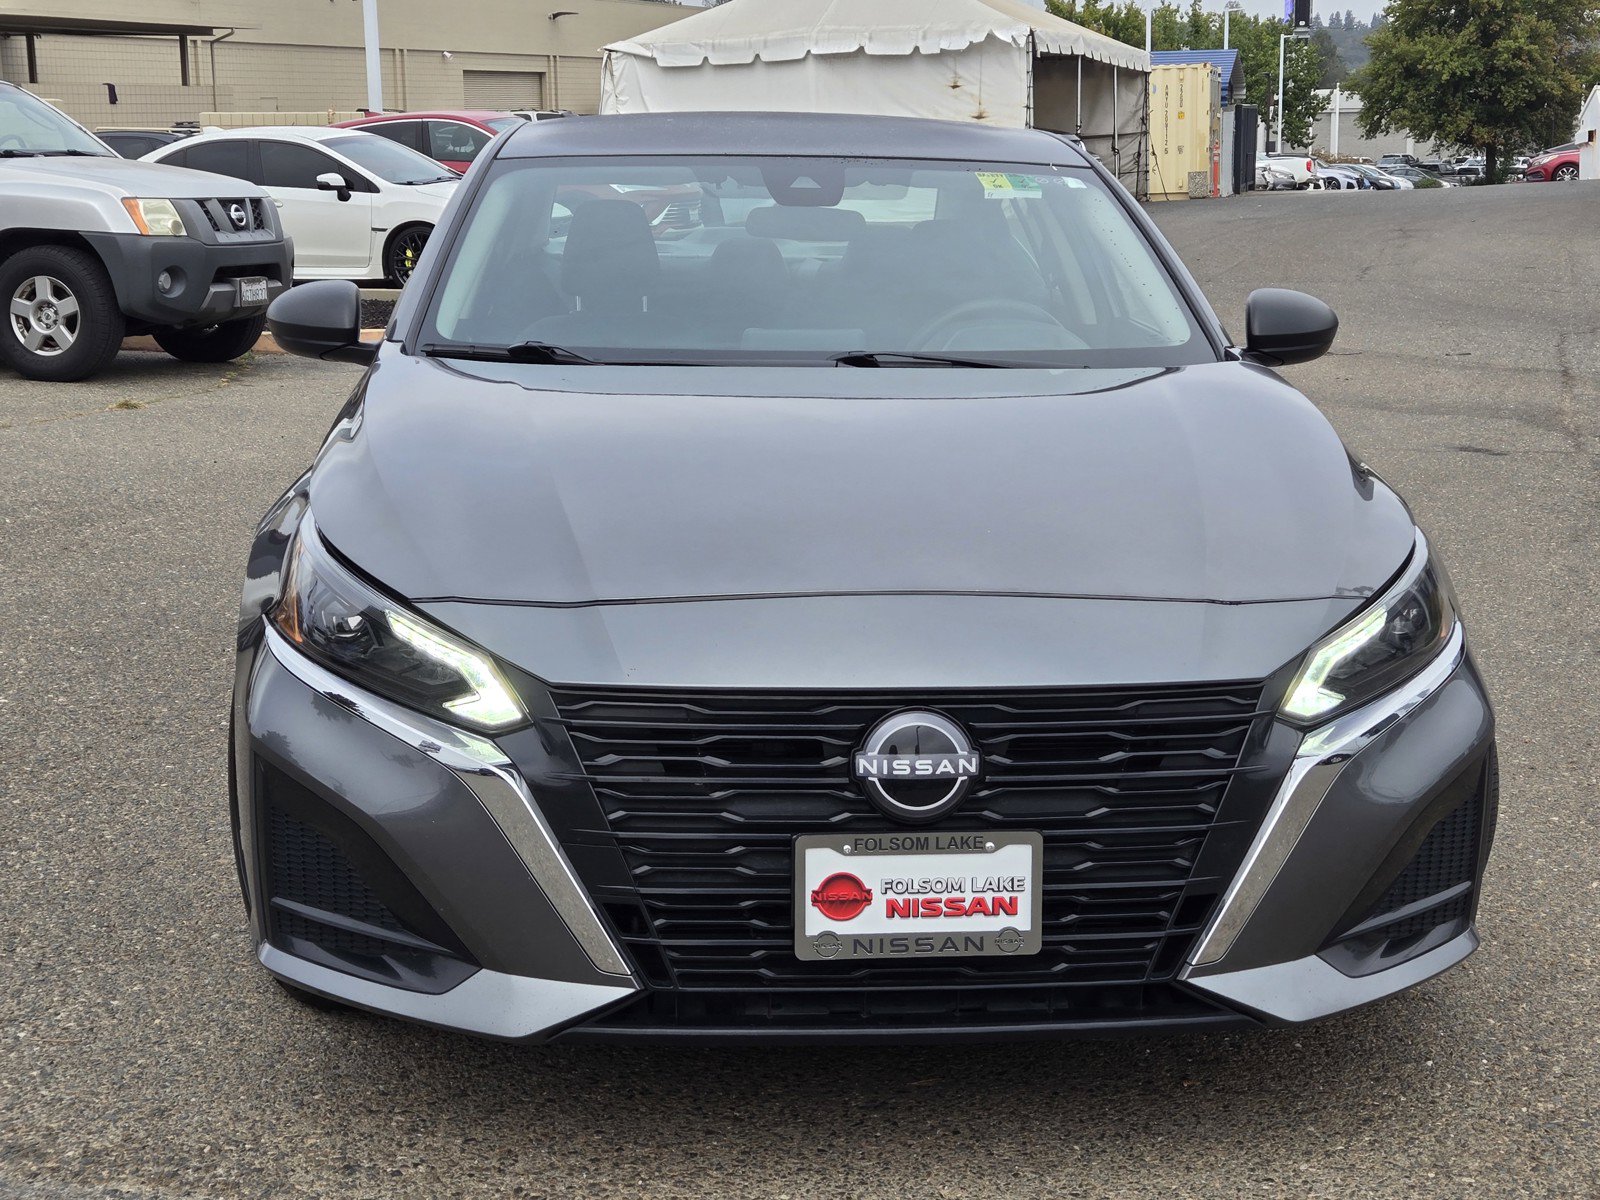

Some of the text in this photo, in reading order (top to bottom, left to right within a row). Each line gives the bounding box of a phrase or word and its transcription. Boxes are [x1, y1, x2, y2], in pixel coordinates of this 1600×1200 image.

[858, 757, 977, 775] NISSAN
[854, 835, 984, 852] FOLSOM LAKE
[880, 875, 1026, 895] FOLSOM LAKE
[810, 891, 874, 902] NISSAN
[885, 895, 1019, 919] NISSAN
[853, 935, 985, 955] NISSAN
